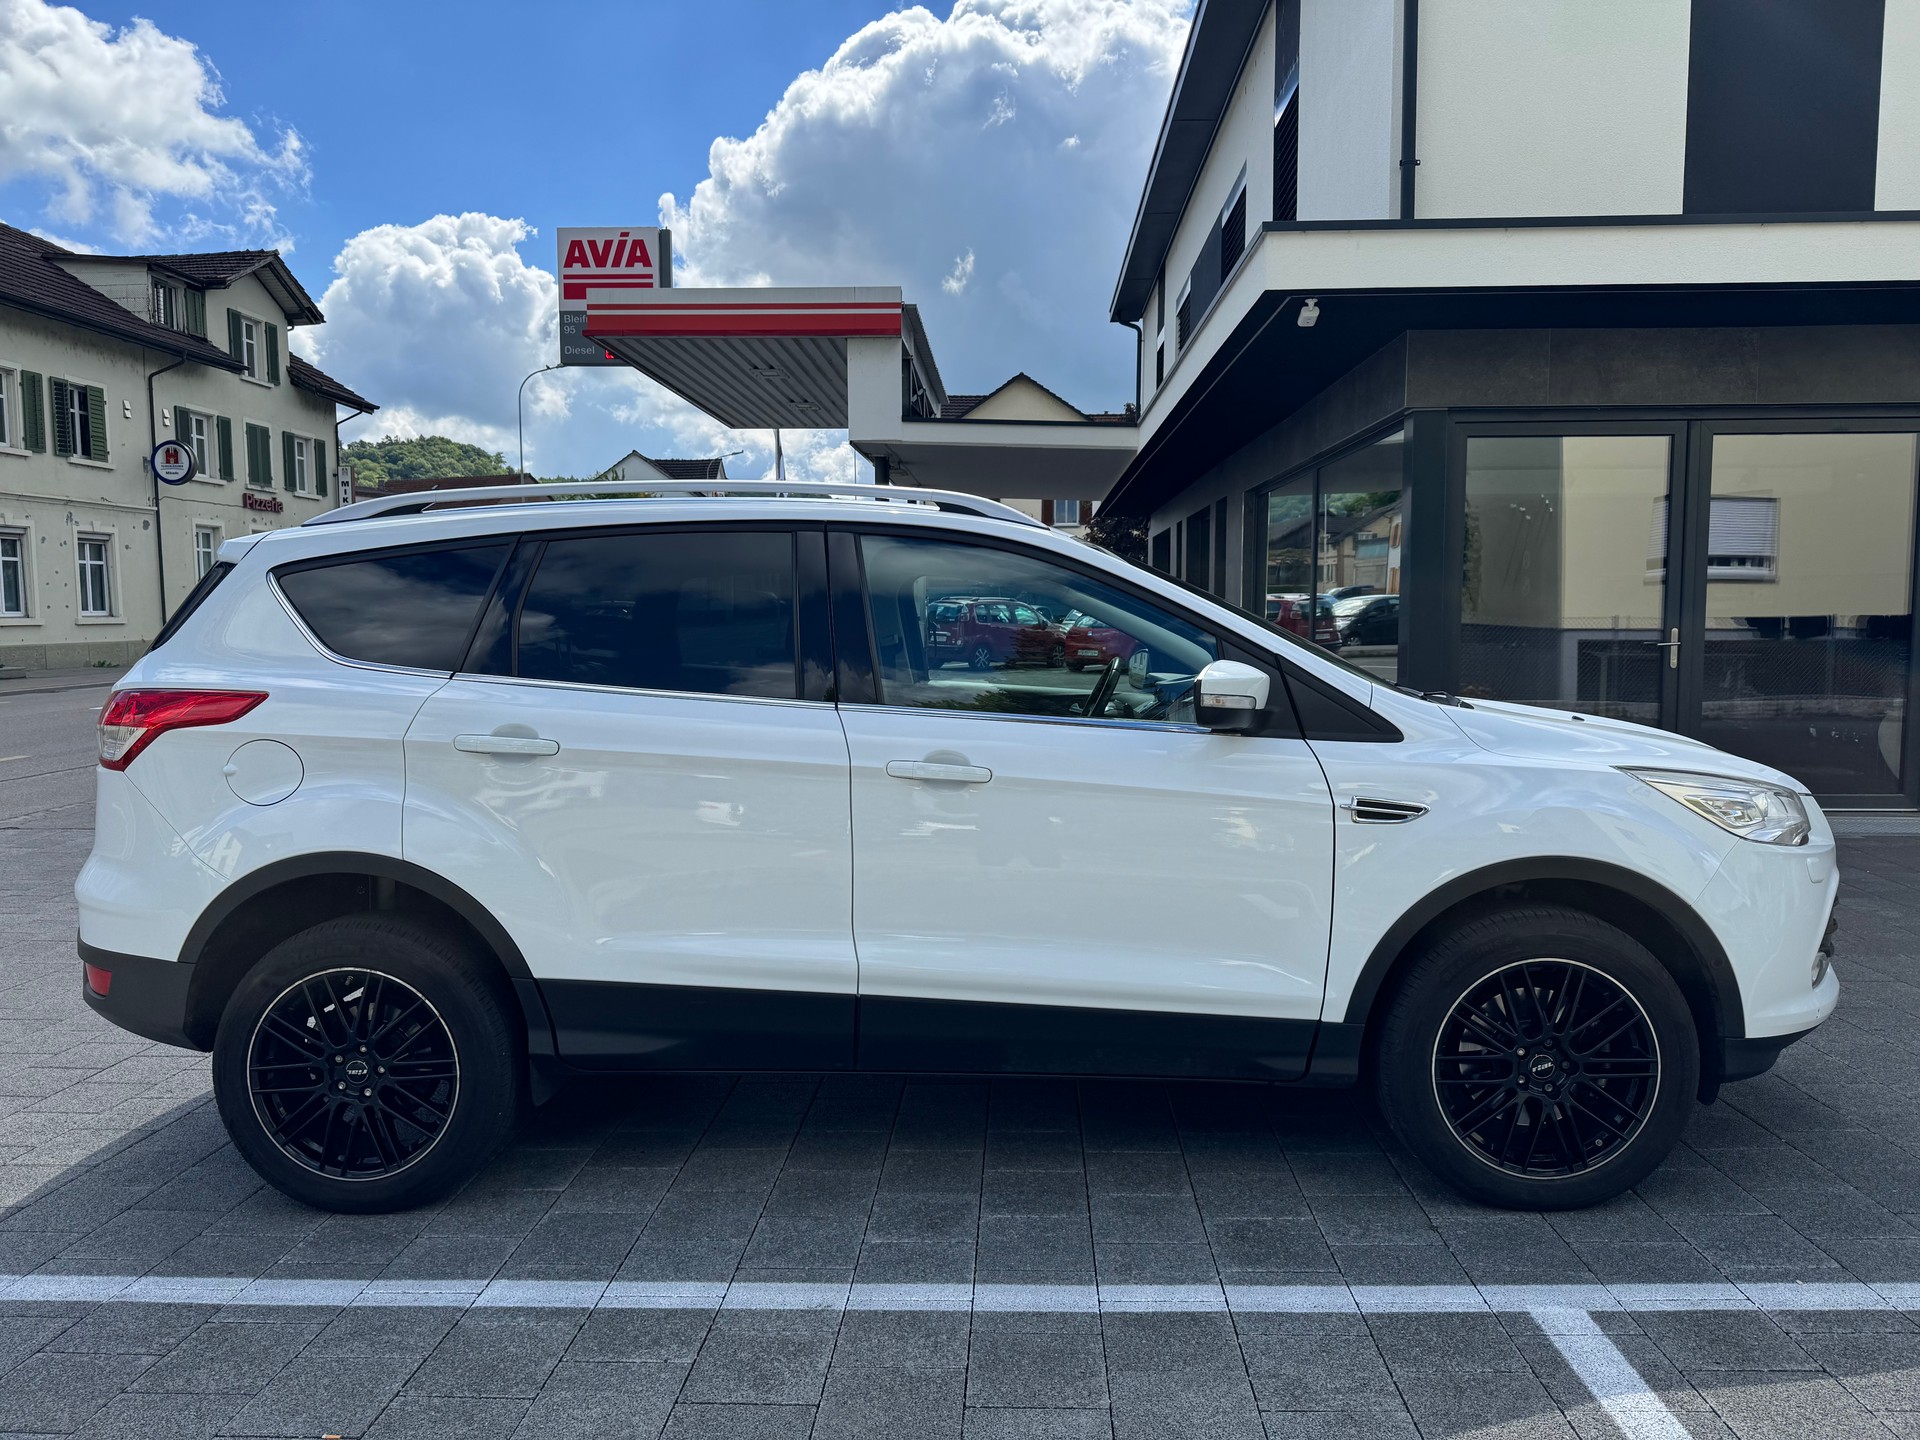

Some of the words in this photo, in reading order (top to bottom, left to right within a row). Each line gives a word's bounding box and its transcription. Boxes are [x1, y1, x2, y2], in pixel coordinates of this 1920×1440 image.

[563, 325, 576, 334] 95
[564, 345, 595, 354] Diesel
[341, 481, 350, 506] MIK
[246, 493, 284, 513] Pizzeria
